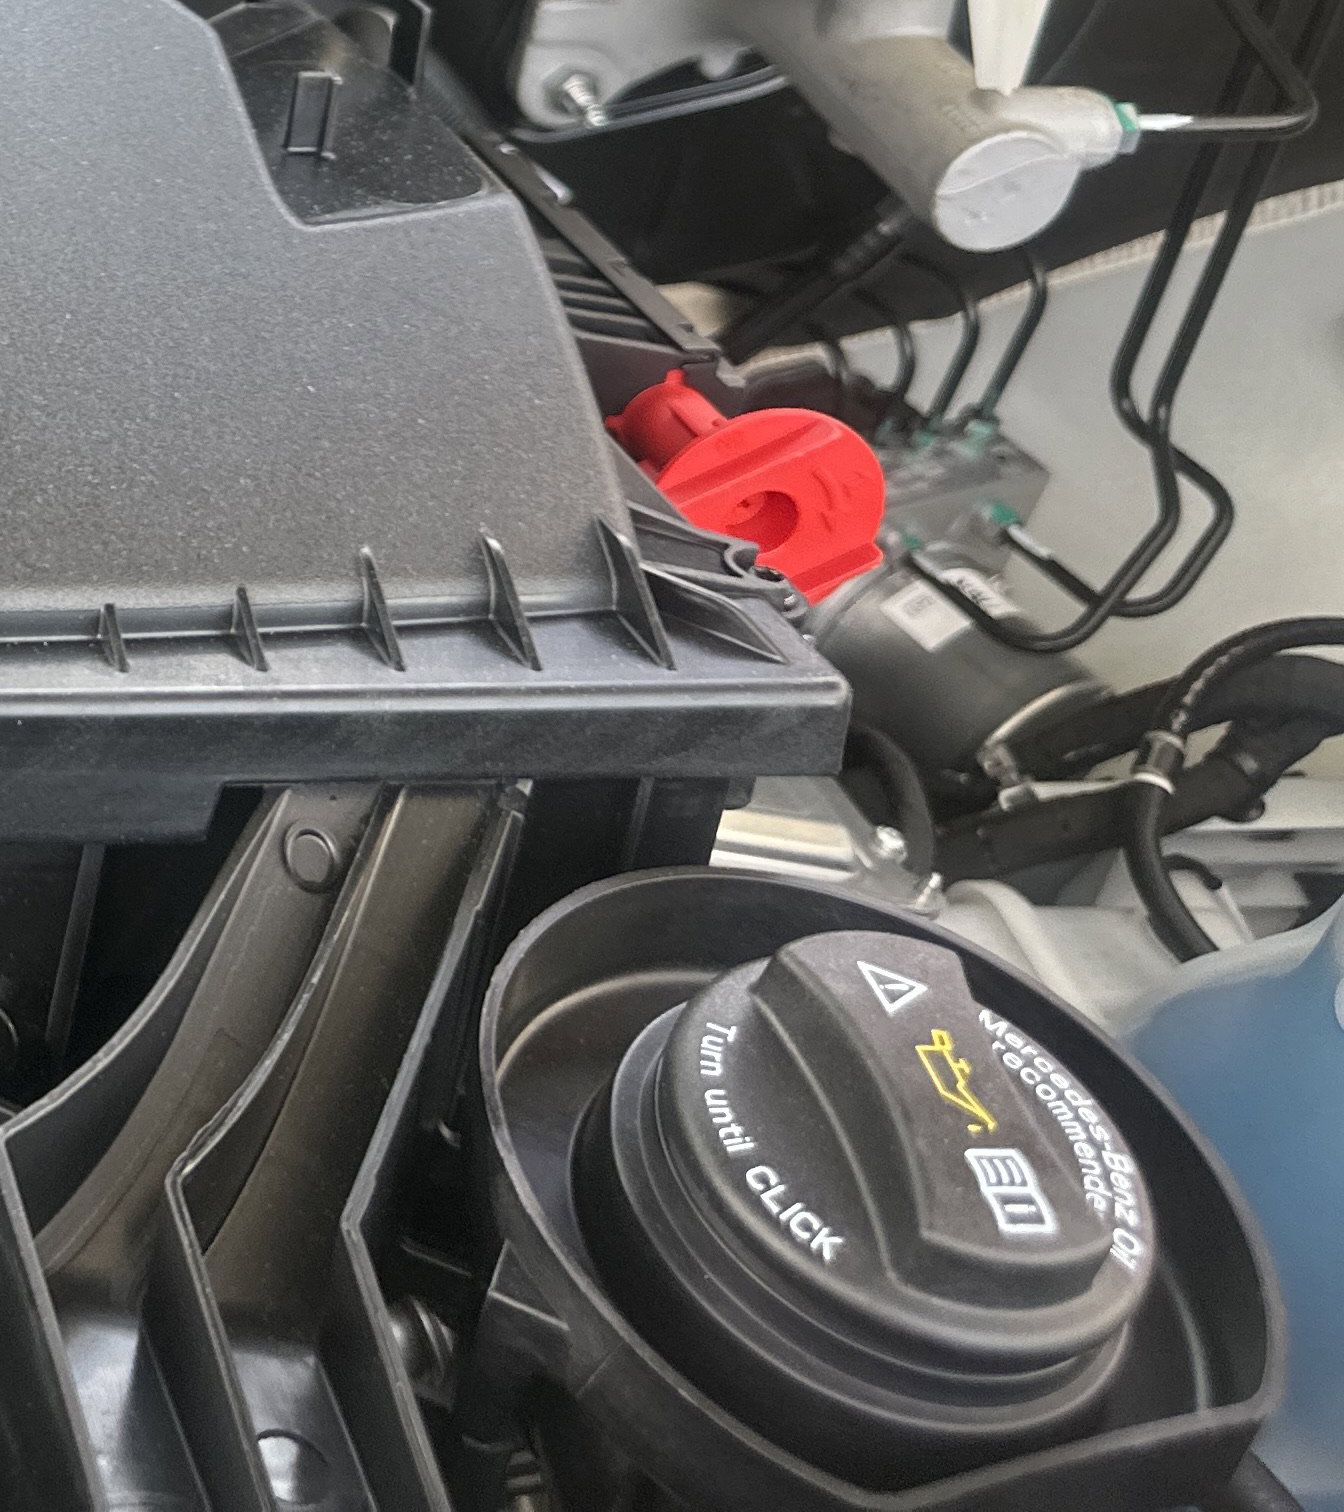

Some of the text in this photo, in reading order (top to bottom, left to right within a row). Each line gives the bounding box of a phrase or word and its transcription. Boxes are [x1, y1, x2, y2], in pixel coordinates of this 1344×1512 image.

[699, 1022, 844, 1261] Turn until CLICK
[978, 1009, 1142, 1270] Mercedes-Benz Oil
[991, 1040, 1113, 1220] recommende
